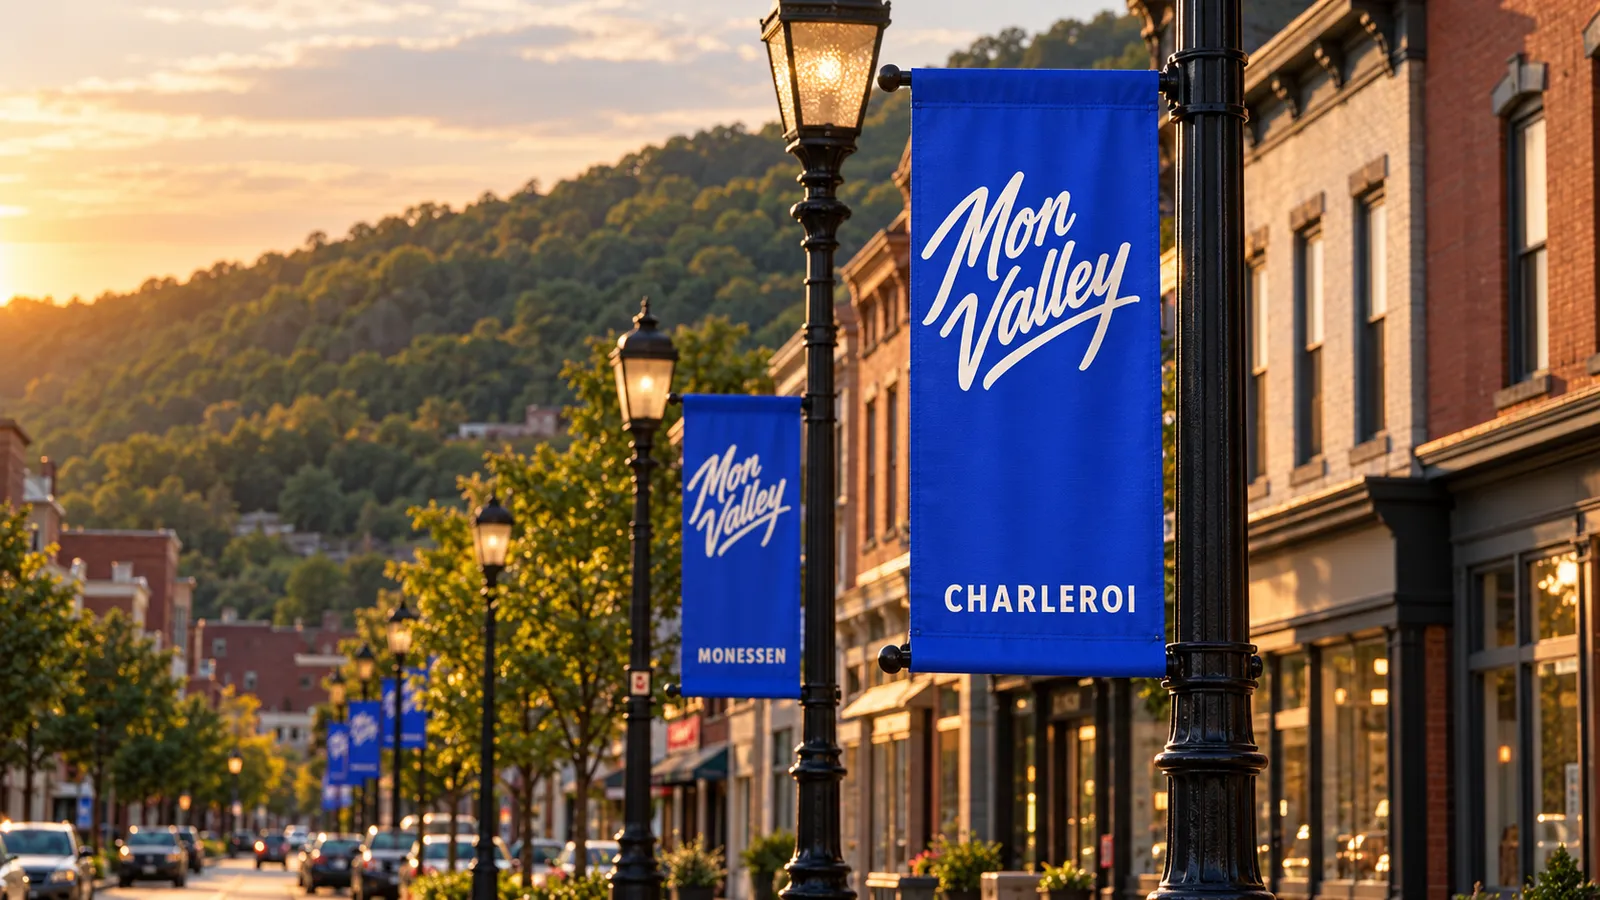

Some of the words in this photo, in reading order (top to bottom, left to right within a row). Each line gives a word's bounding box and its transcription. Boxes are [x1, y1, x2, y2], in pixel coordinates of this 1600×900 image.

[921, 171, 1077, 326] Mon
[940, 240, 1141, 391] Valley
[687, 444, 762, 525] Mon
[697, 478, 791, 558] Valley
[944, 583, 1136, 614] CHARLEROI
[698, 647, 787, 664] MONESSEN
